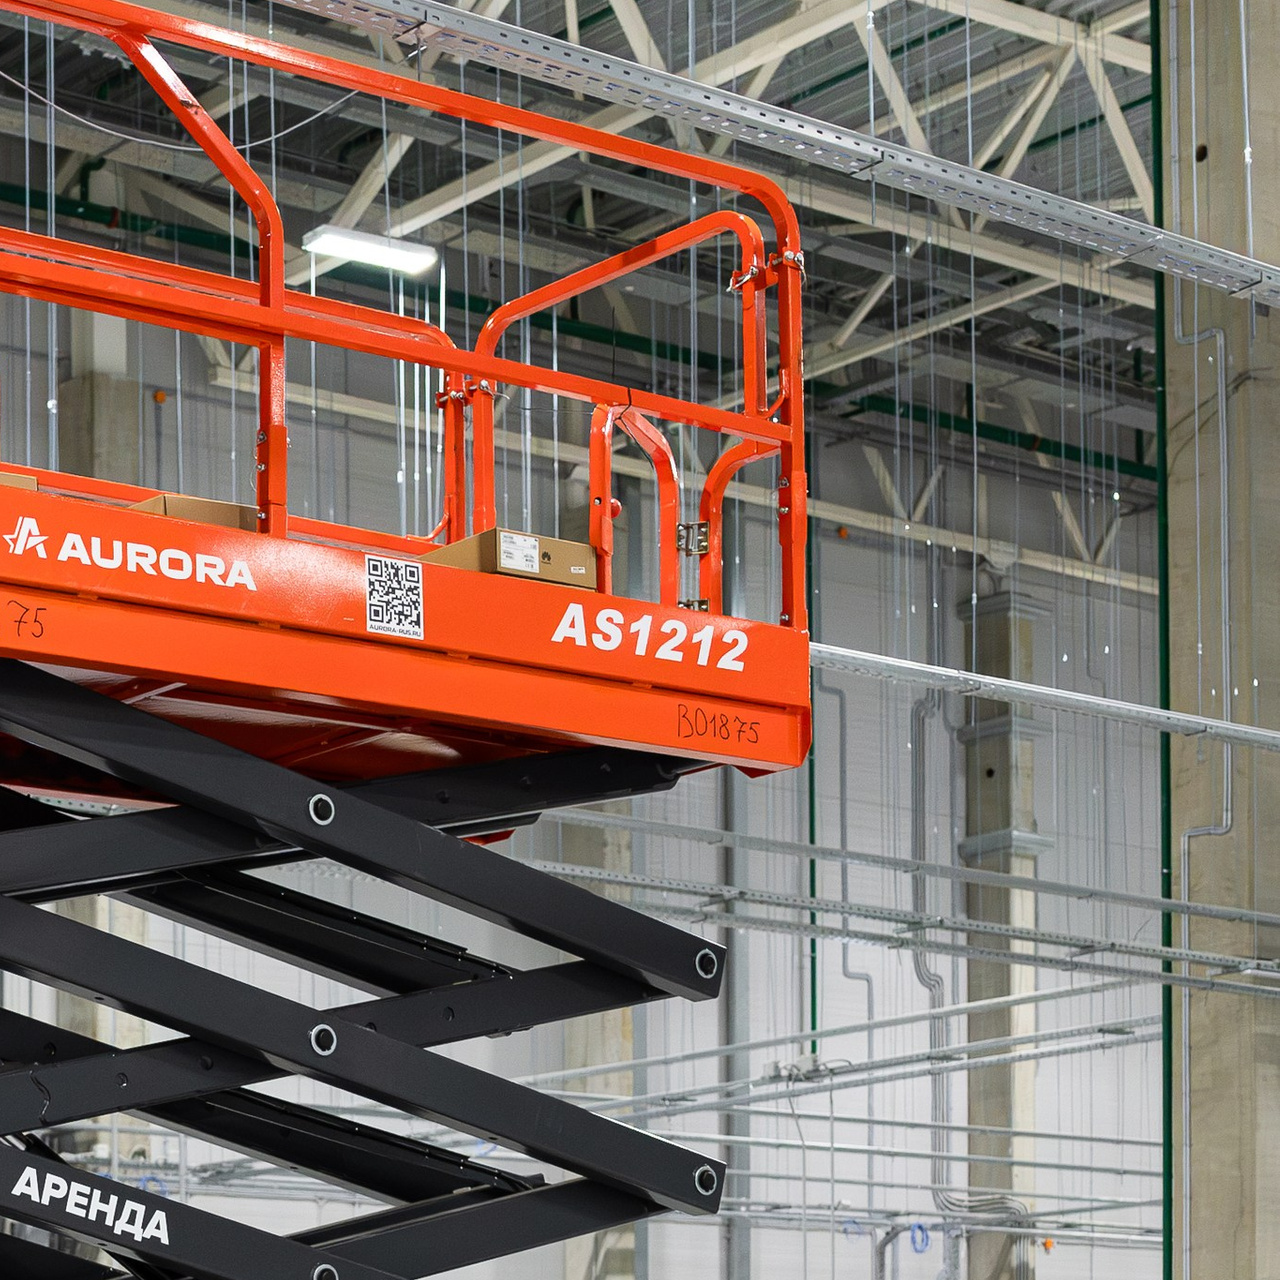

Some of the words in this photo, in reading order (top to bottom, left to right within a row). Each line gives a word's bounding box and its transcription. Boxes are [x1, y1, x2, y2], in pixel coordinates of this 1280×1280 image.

[57, 532, 258, 592] AURORA
[551, 602, 749, 672] AS1212
[11, 1166, 170, 1245] АРЕНДА
